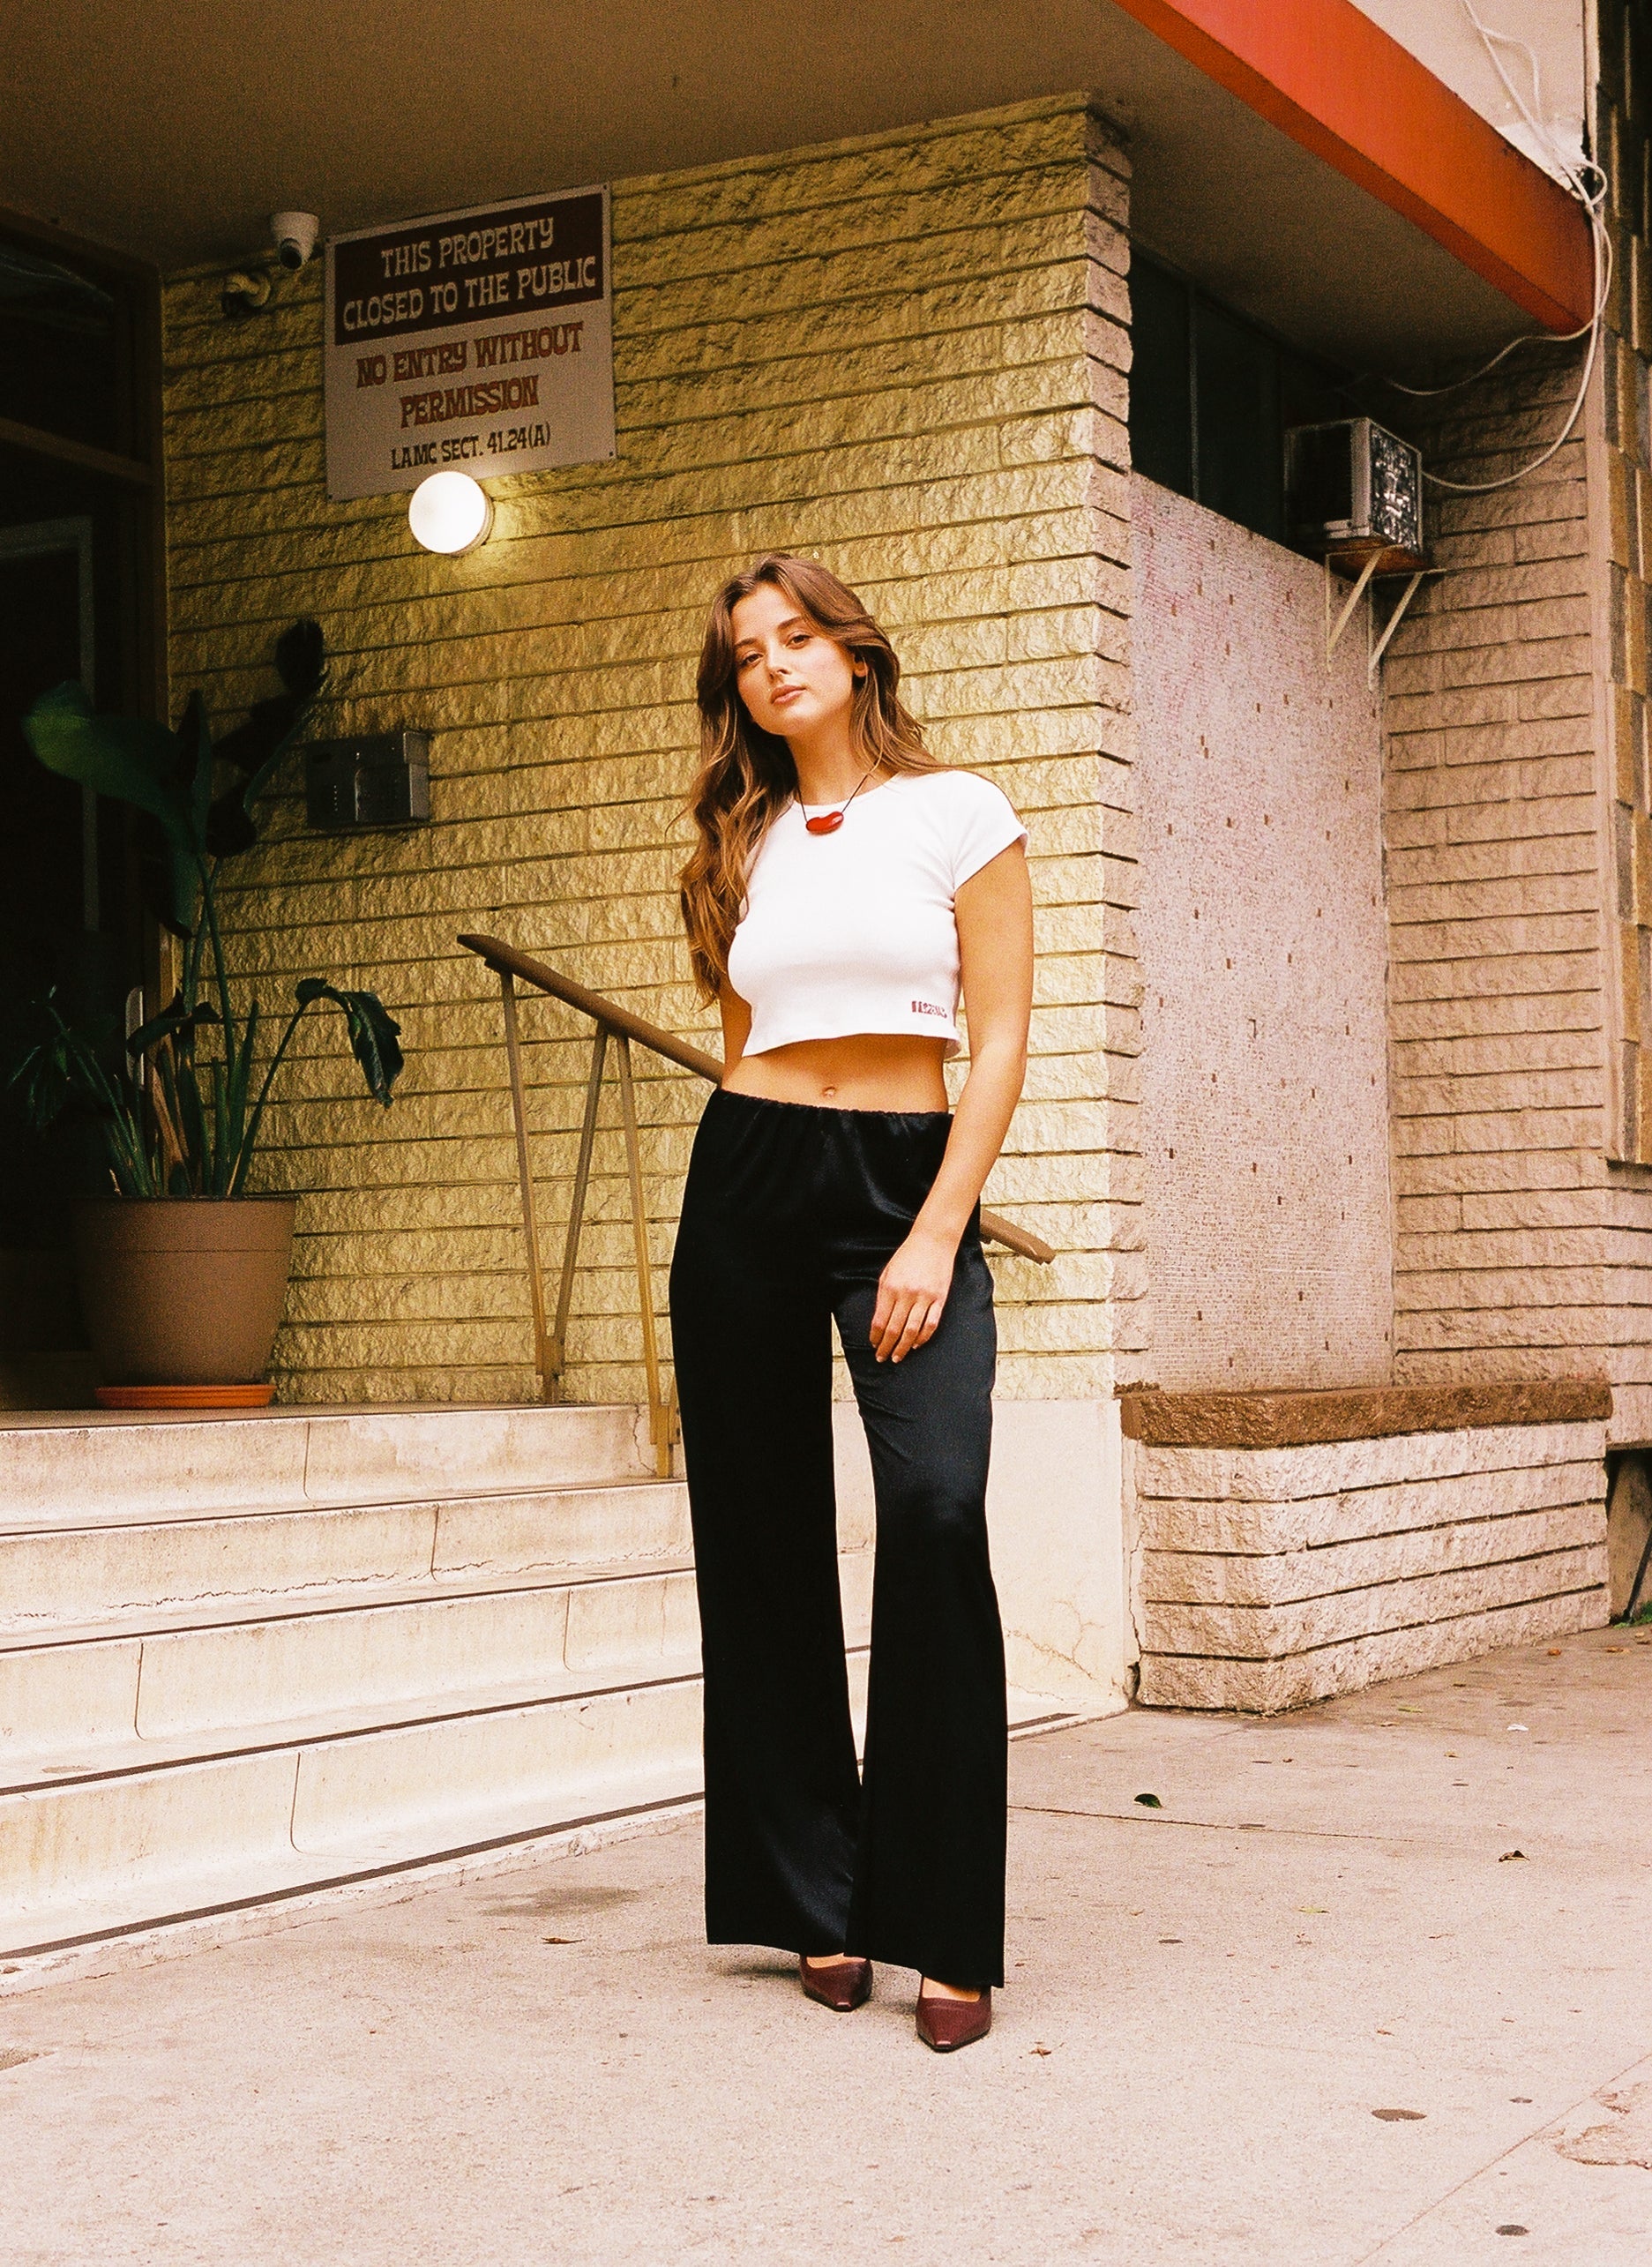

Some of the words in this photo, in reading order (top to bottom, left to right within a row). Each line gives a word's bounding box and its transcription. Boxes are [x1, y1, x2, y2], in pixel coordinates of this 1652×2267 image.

[381, 241, 431, 278] THIS
[439, 217, 554, 268] PROPERTY
[343, 288, 423, 331] CLOSED
[430, 282, 458, 314] TO
[464, 272, 509, 308] THE
[516, 256, 596, 297] PUBLIC
[356, 355, 387, 388] NO
[392, 341, 467, 382] ENTRY
[475, 321, 584, 368] WITHOUT
[400, 375, 539, 429] PERMISSION
[391, 444, 437, 470] LAMC
[442, 436, 483, 463] SECT.
[487, 422, 550, 453] 41.24(A)
